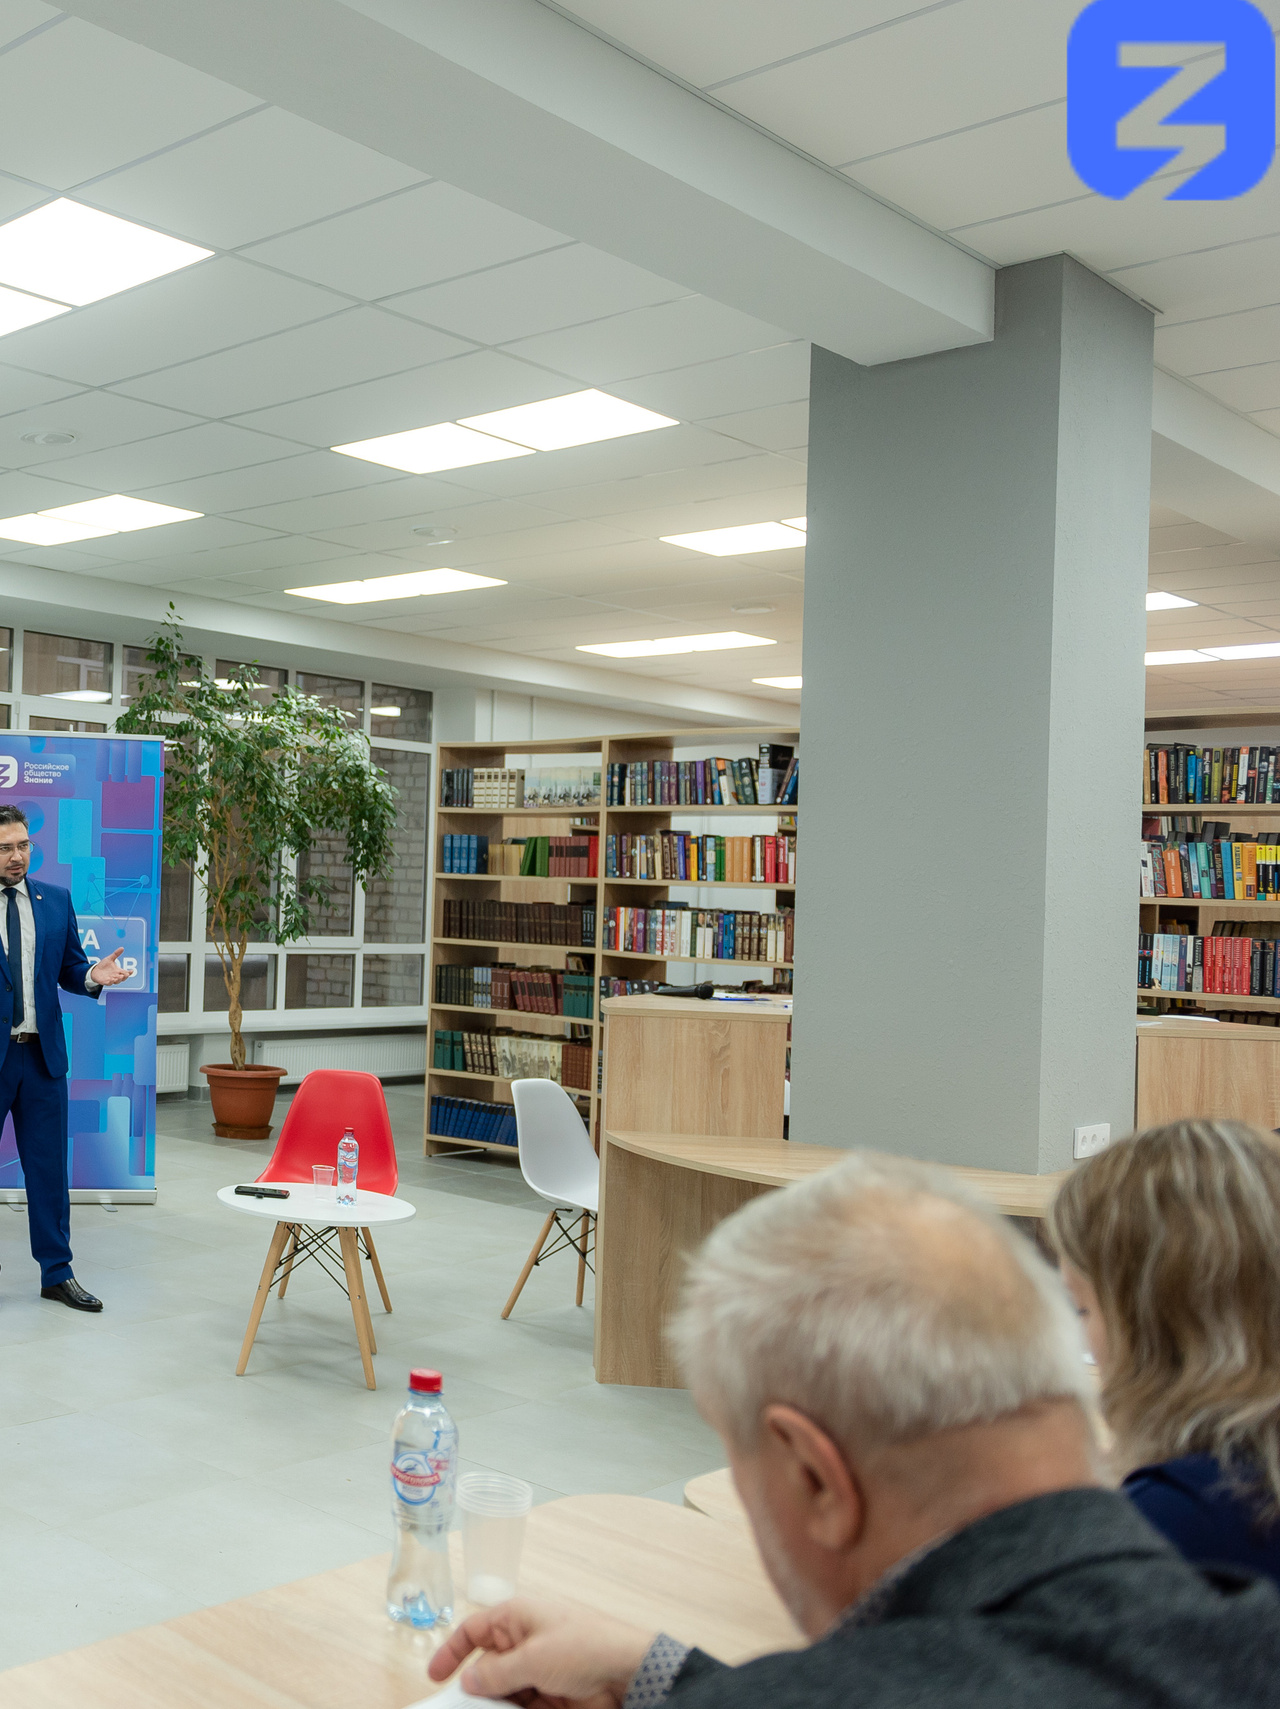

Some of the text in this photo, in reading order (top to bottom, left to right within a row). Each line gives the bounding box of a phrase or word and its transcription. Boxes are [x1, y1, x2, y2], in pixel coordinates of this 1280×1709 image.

[24, 762, 70, 772] Российское
[23, 769, 62, 778] общество
[23, 776, 53, 784] Знание
